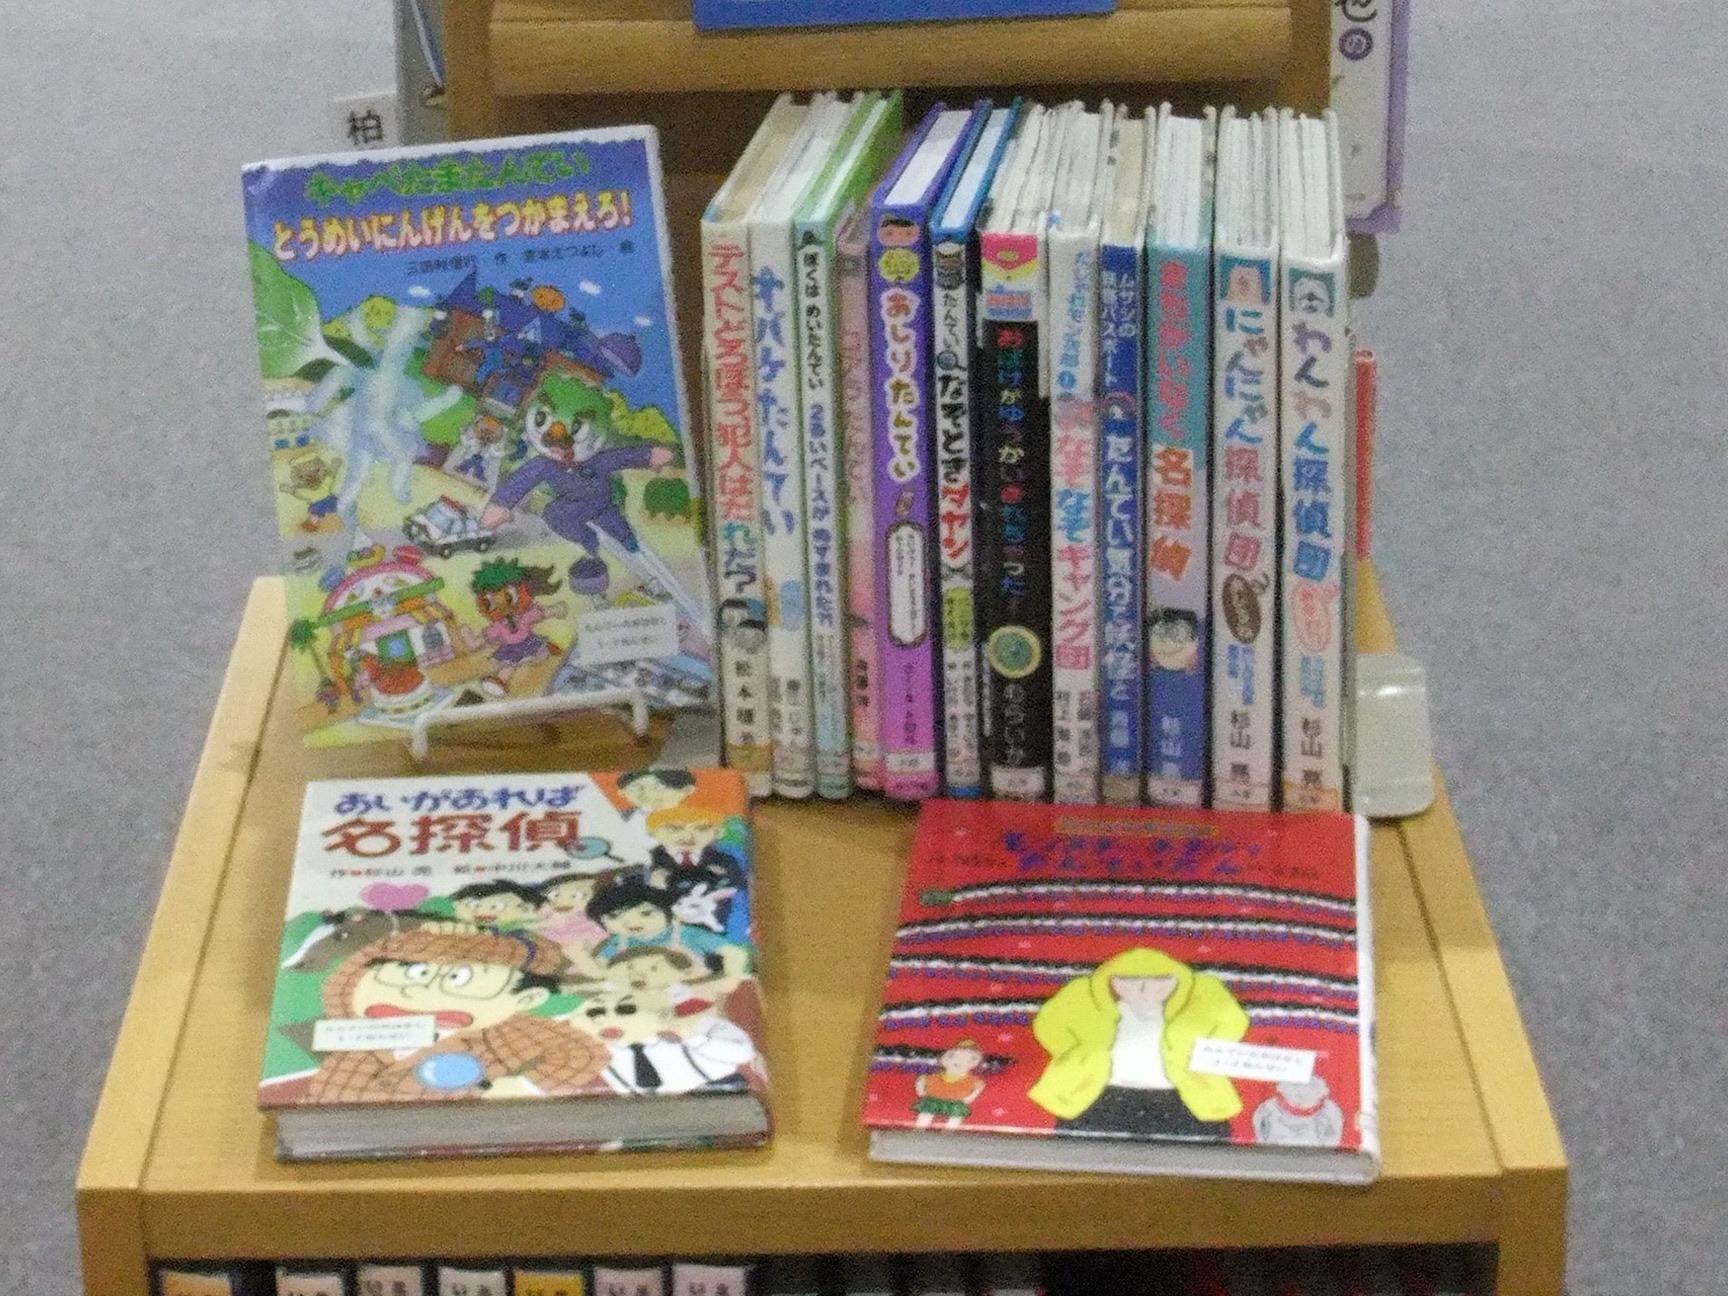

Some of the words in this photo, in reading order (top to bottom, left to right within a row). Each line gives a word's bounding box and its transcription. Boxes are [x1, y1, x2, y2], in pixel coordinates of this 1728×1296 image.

[346, 108, 385, 146] 柏
[273, 189, 634, 261] とうめいにんげんをつかまえろ!
[885, 292, 917, 479] おしりたんてい
[1292, 320, 1332, 582] わんわん探偵団
[1151, 446, 1194, 582] 名探偵
[322, 810, 584, 858] 名探偵
[334, 783, 586, 815] あいがあれば
